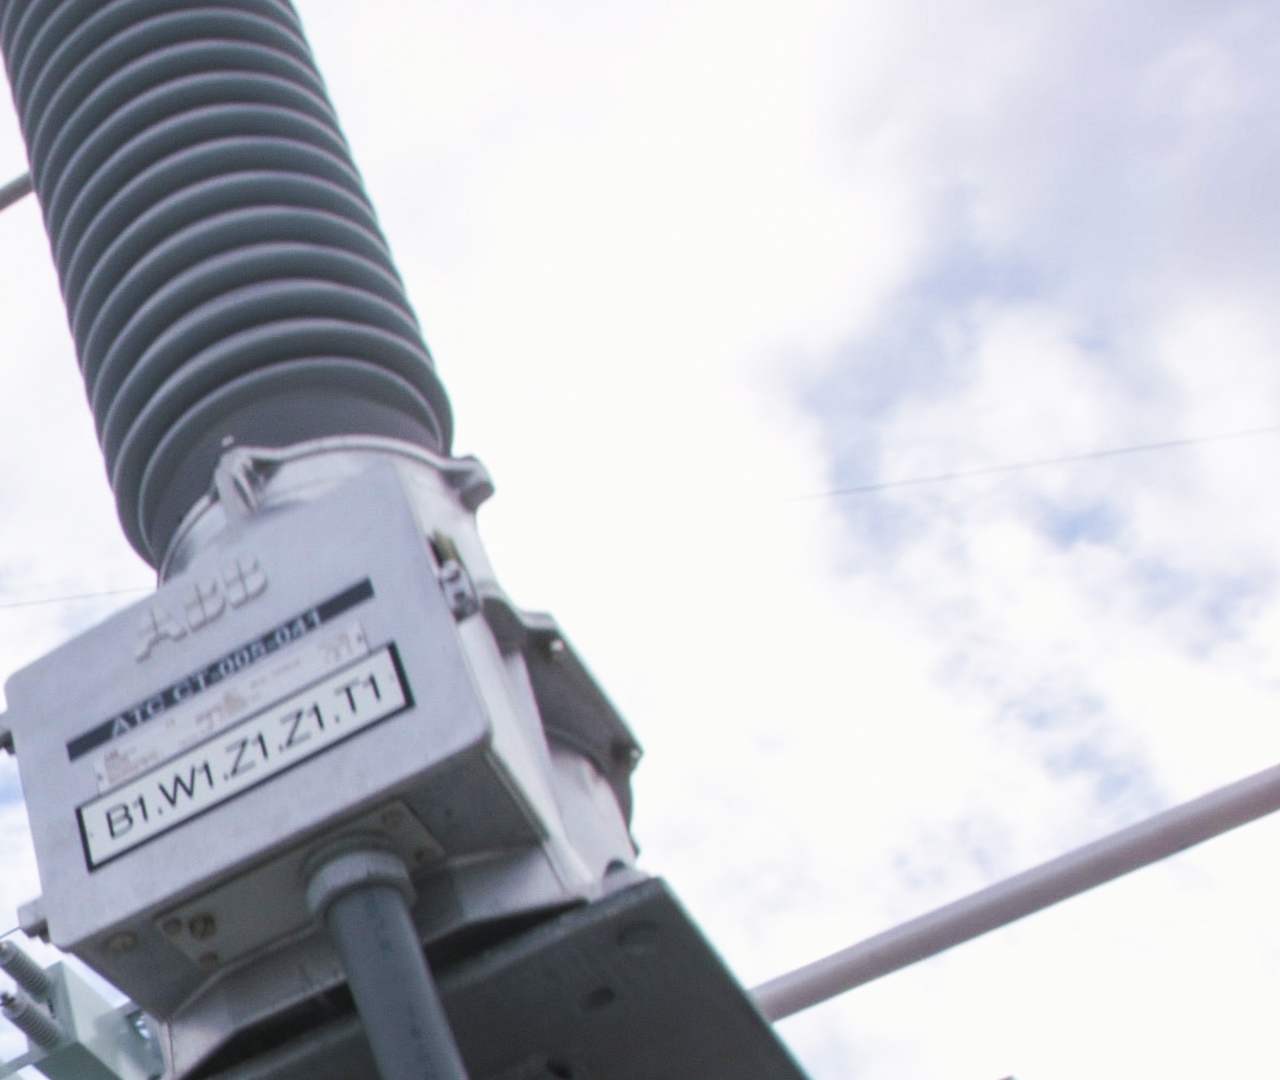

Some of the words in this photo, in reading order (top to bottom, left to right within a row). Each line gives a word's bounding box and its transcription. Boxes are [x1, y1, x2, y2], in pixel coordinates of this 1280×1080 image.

[135, 554, 268, 662] ABB
[105, 673, 381, 839] B1.W1.Z1.Z1.T1
[111, 695, 163, 739] ATC
